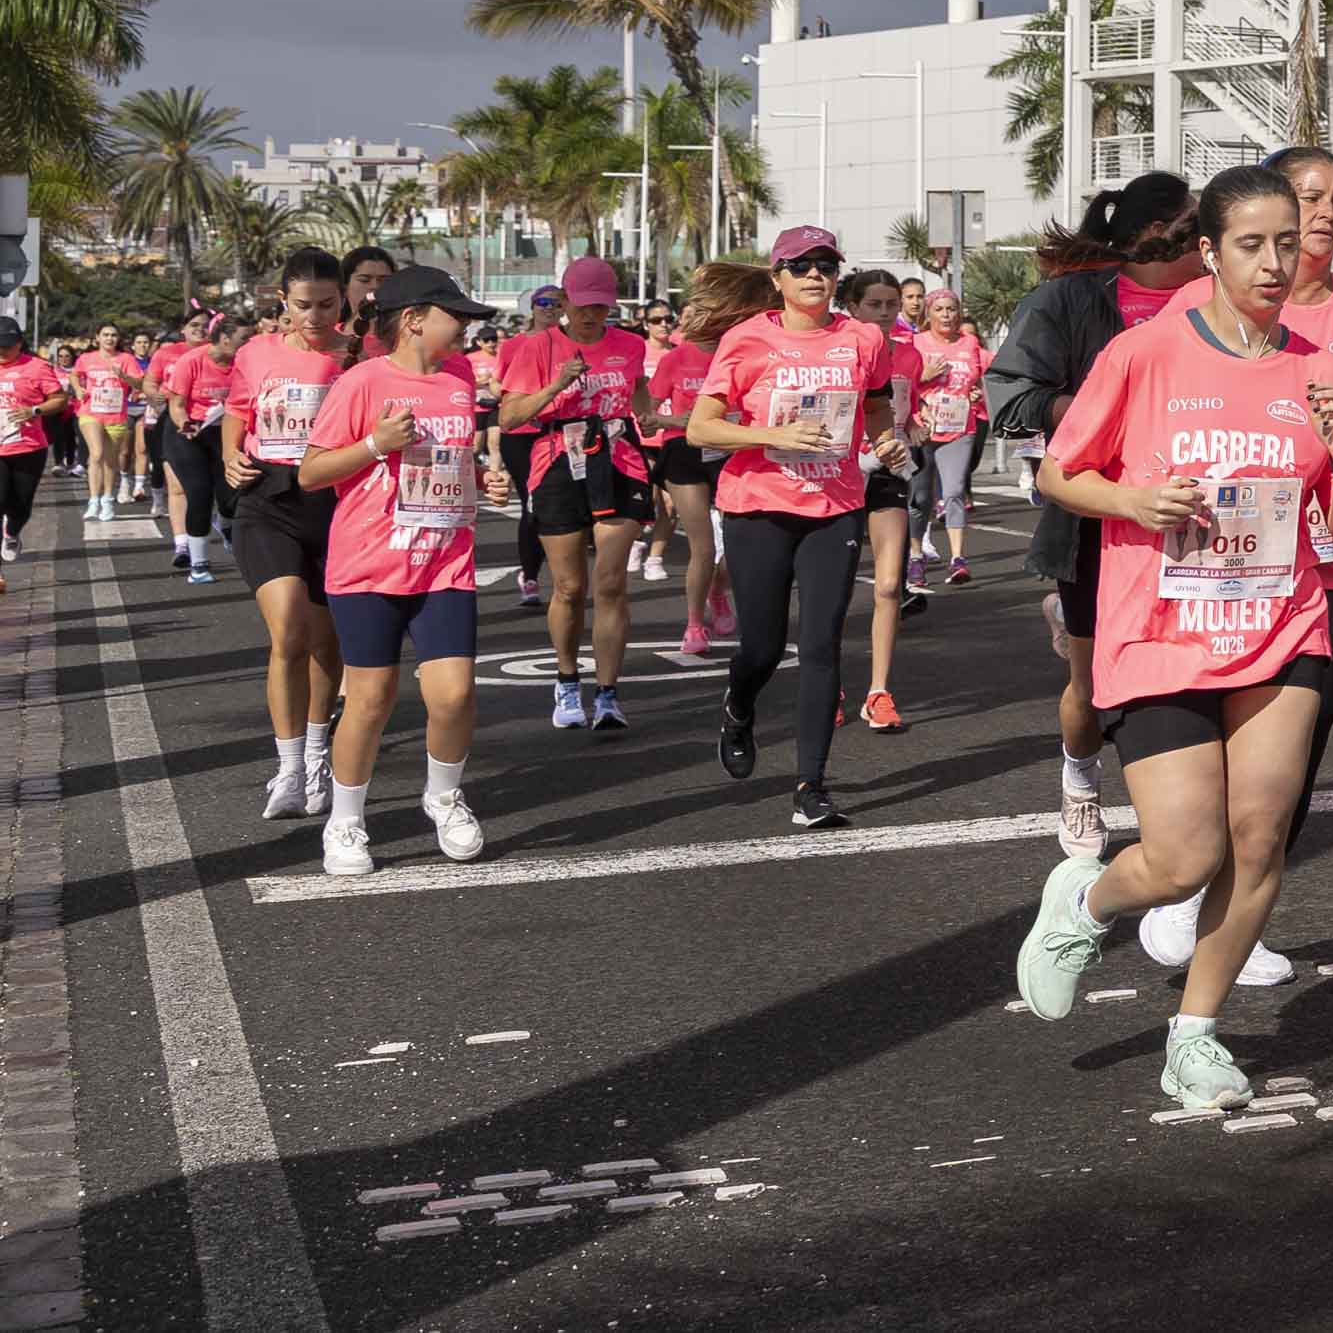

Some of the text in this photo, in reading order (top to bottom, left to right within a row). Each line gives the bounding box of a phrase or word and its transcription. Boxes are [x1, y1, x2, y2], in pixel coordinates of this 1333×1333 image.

[776, 366, 853, 388] CARRERA
[1168, 397, 1224, 412] OYSHO
[413, 416, 473, 440] RRERA
[1172, 429, 1296, 472] CARRERA
[433, 482, 462, 497] 016
[1212, 534, 1257, 555] 016
[1224, 557, 1245, 567] 3000
[1210, 569, 1220, 578] LA
[1178, 598, 1272, 633] MUJER
[1211, 634, 1245, 655] 2026
